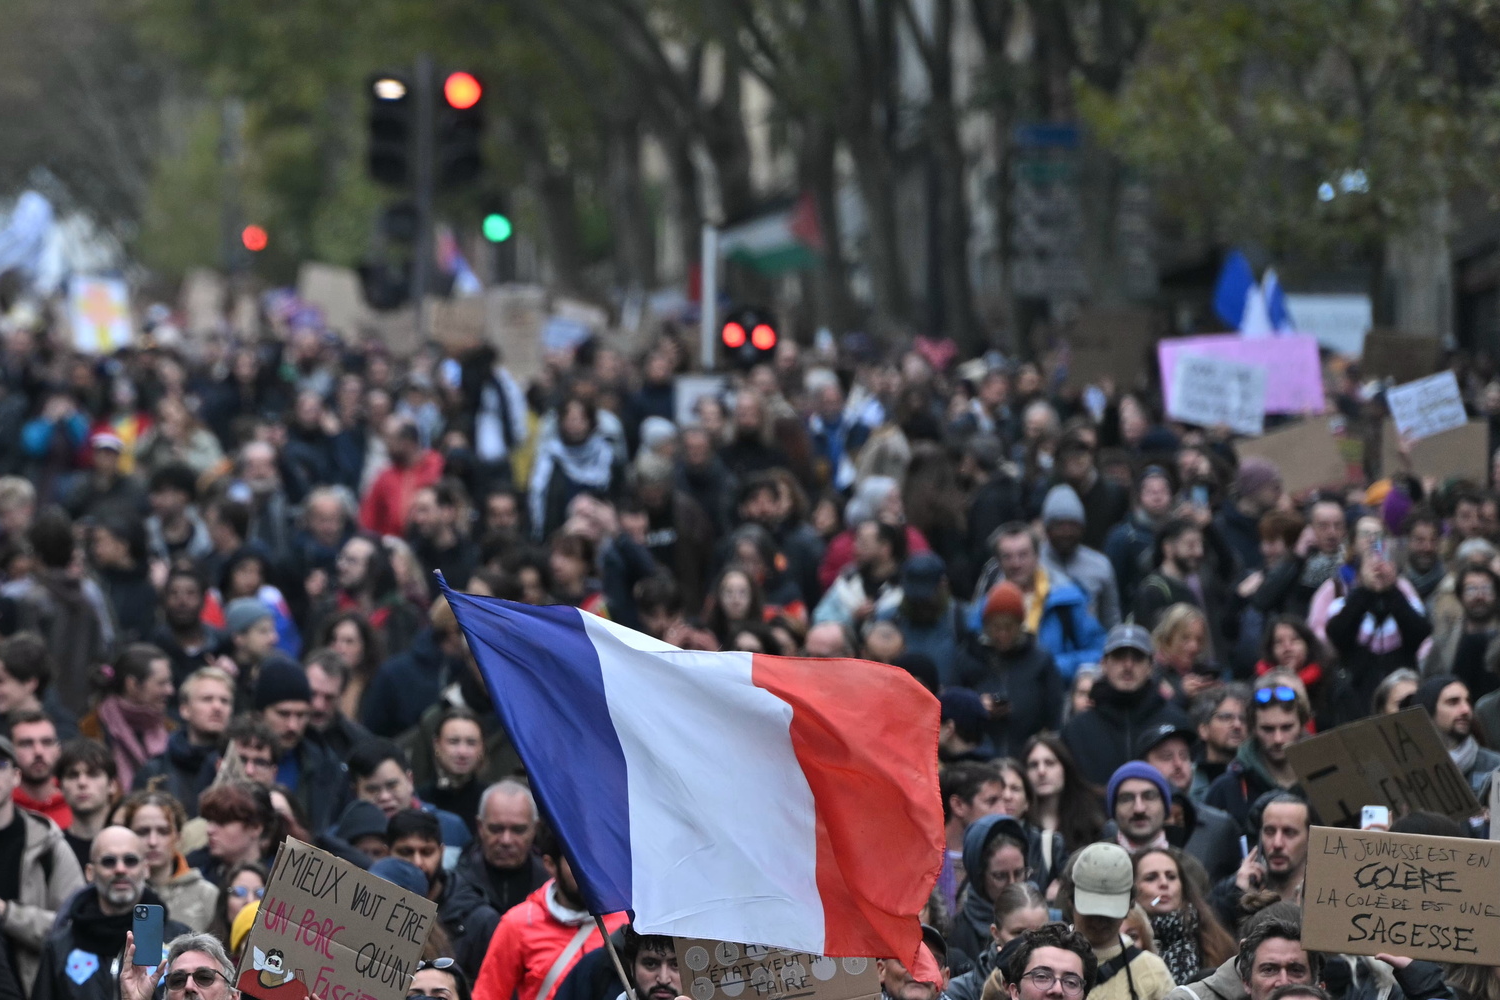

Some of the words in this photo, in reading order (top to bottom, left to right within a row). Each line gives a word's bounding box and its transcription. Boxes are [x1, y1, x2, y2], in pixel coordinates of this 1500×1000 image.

[1324, 836, 1347, 859] LA
[1353, 837, 1423, 862] JEUNESSE
[1428, 848, 1457, 862] EST
[1467, 848, 1492, 868] EN
[1354, 861, 1461, 893] COLÈRE
[279, 847, 347, 904] MIEUX
[350, 882, 386, 921] VAUT
[385, 897, 427, 945] ÊTRE
[1317, 887, 1342, 908] LA
[1345, 893, 1413, 911] COLÈRE
[1421, 900, 1453, 912] EST
[1460, 904, 1500, 918] UNE
[264, 897, 295, 936] UN
[295, 908, 345, 960] PORC
[1348, 913, 1478, 954] SAGESSE
[692, 962, 755, 987] L'ÉTAT
[761, 954, 802, 975] VEUT
[748, 974, 813, 997] TAIRE
